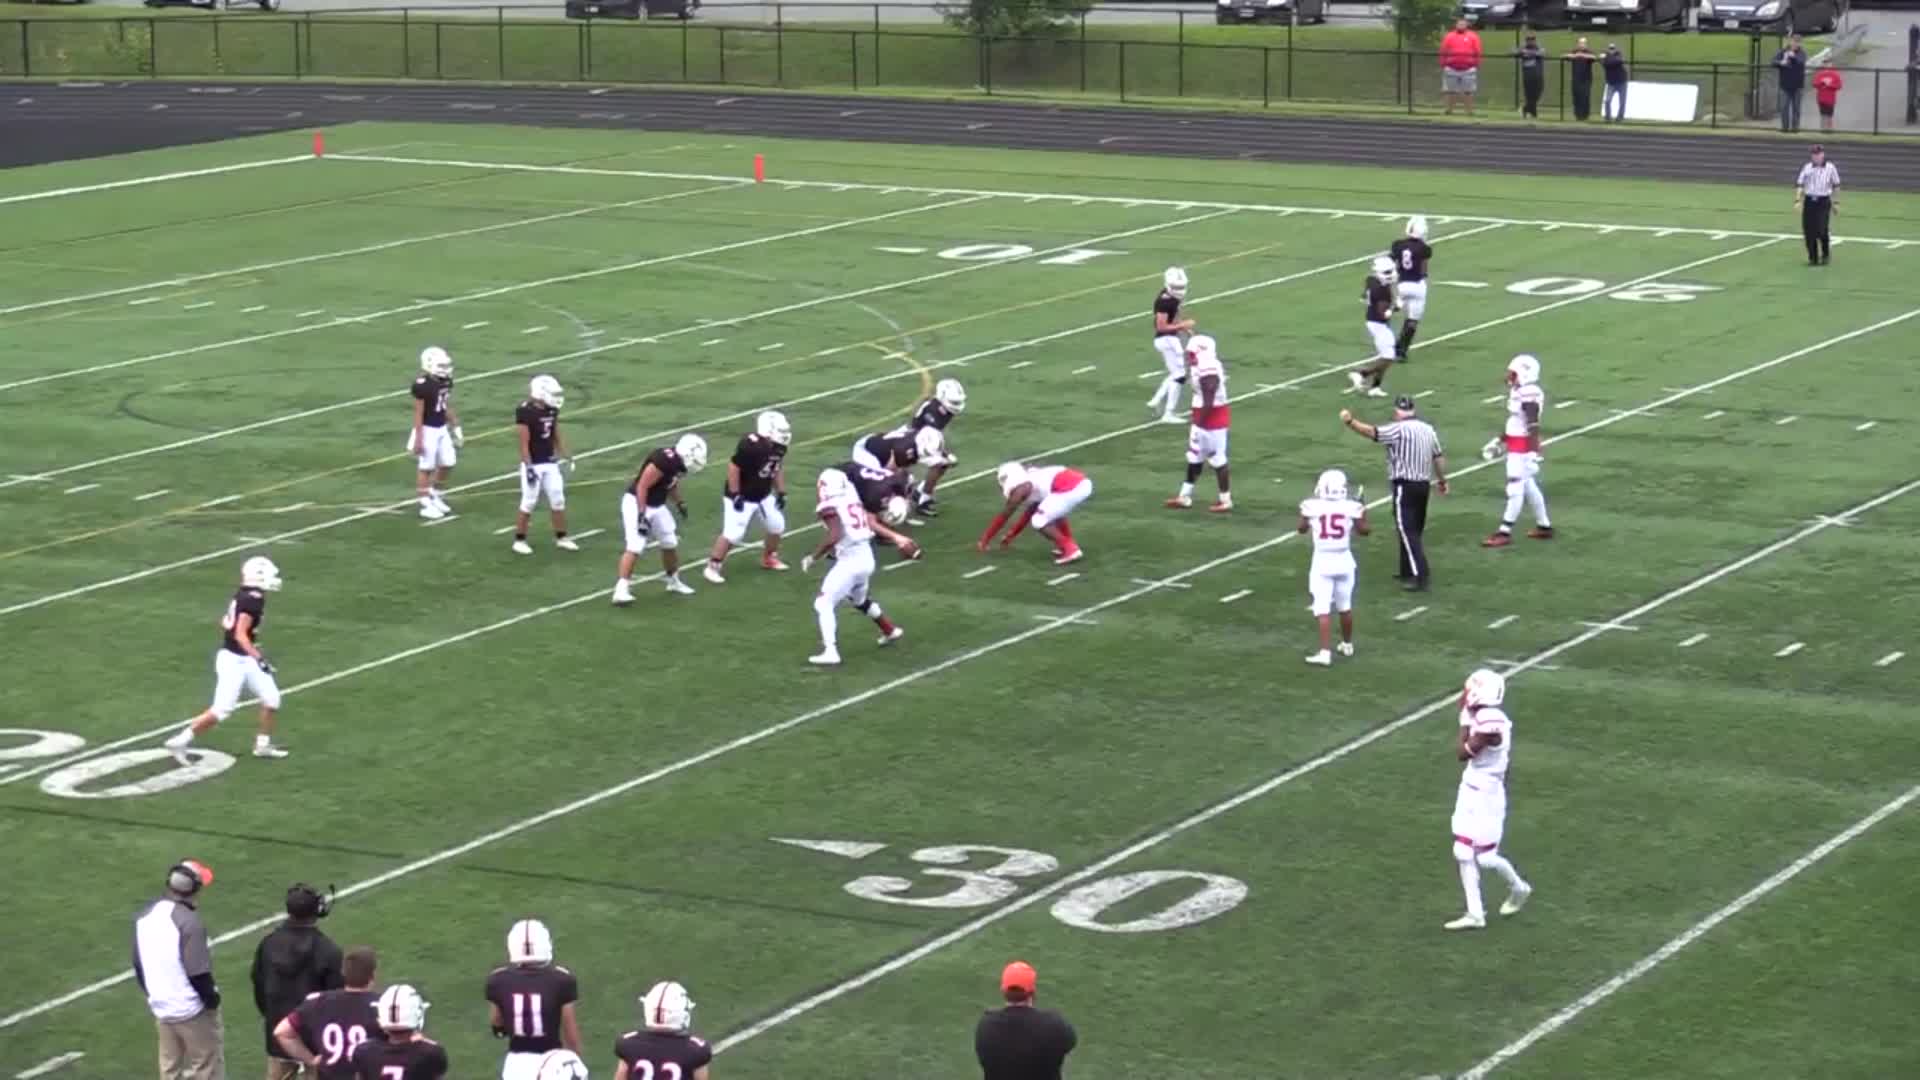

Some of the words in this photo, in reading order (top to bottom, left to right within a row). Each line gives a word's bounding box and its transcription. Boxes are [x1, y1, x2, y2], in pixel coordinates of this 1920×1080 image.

[1402, 248, 1413, 270] 8
[1319, 513, 1346, 540] 15
[842, 845, 1249, 933] 30
[512, 993, 545, 1037] 11
[322, 1022, 368, 1065] 98
